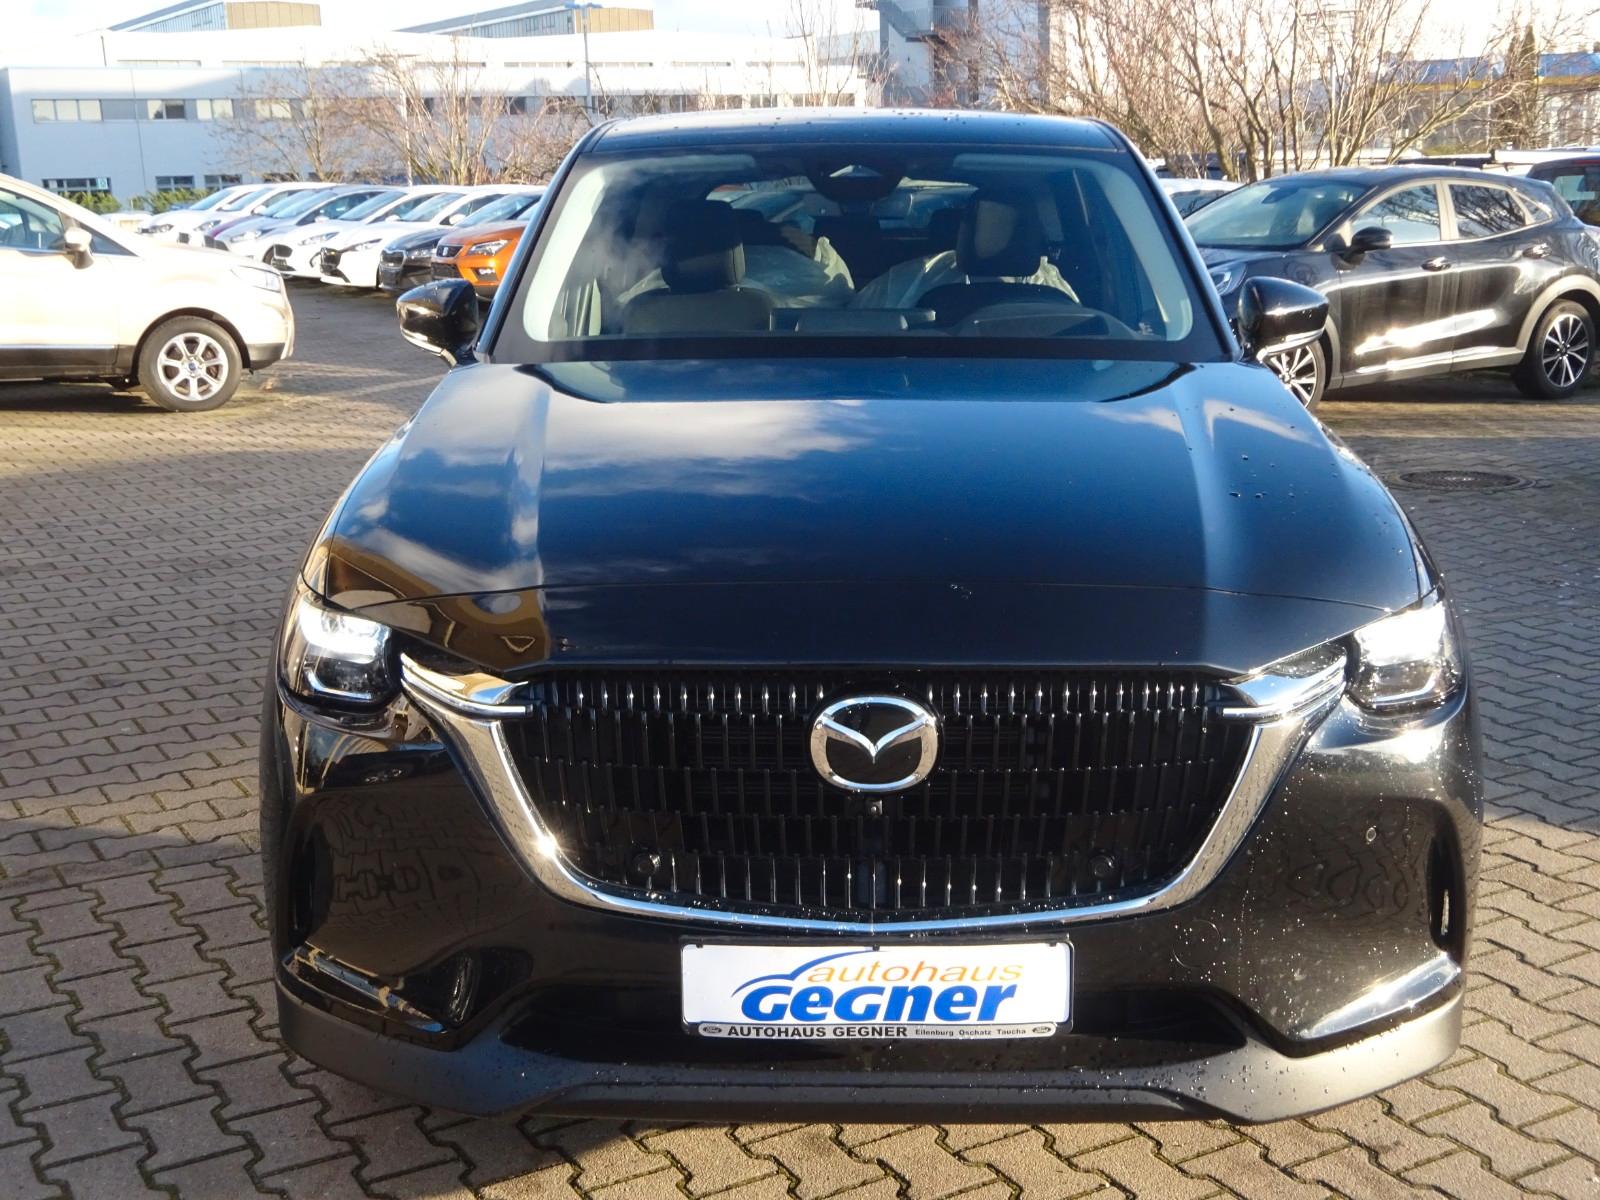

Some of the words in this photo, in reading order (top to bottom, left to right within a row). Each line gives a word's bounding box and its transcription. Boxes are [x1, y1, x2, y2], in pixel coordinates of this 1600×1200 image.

[807, 960, 1024, 983] autohaus
[727, 1026, 826, 1038] AUTOHAUS
[832, 1026, 908, 1038] GEGNER
[915, 1028, 954, 1037] Eilenburg
[958, 1028, 992, 1036] Oschatz
[997, 1028, 1026, 1036] Taucha
